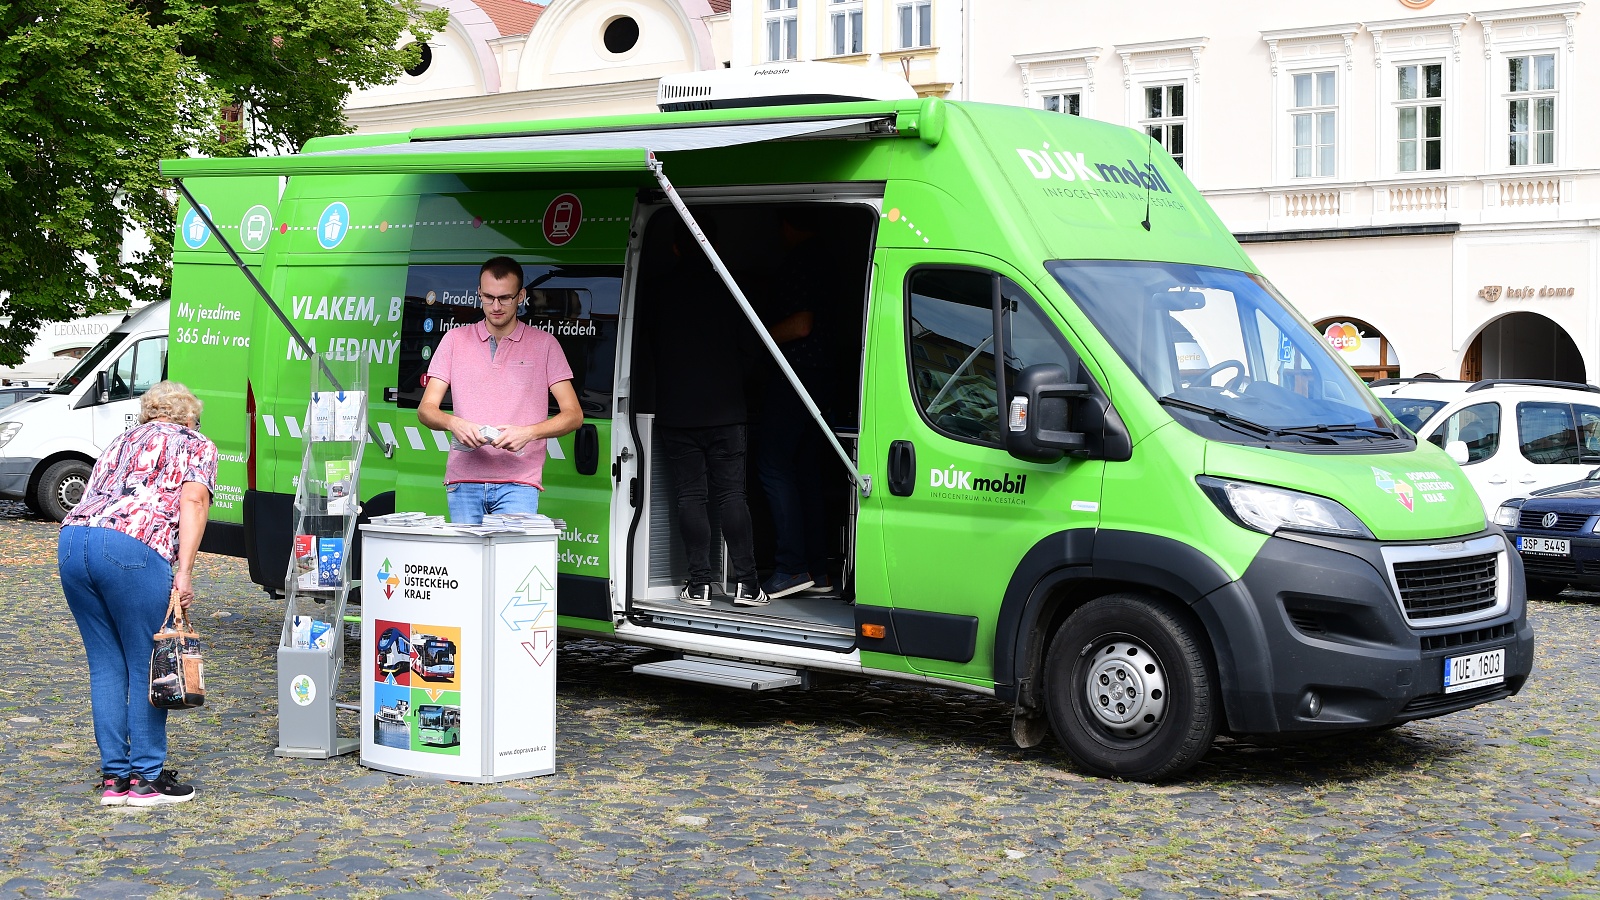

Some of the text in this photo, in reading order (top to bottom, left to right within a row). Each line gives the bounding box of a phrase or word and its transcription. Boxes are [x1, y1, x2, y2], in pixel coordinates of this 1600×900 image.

[1042, 187, 1187, 212] INFOCENTRUM NA ESTÁCH
[442, 290, 478, 309] Prodej
[1506, 285, 1575, 300] kafe doma
[177, 302, 241, 323] My jezdíme
[292, 295, 381, 327] VLAKEM,
[54, 323, 109, 336] LEONARDO
[557, 319, 596, 336] řádech
[176, 327, 199, 344] 365
[202, 327, 221, 346] dní
[223, 336, 230, 346] v
[1328, 334, 1357, 348] teta
[286, 331, 401, 365] NA JEDINÝ
[214, 484, 242, 494] DOPRAVA
[215, 500, 233, 509] KRAJE
[930, 491, 979, 502] INFOCENTRUM
[995, 497, 1026, 506] CESTÁCH
[1523, 538, 1566, 552] 3SP 5449
[404, 563, 449, 577] DOPRAVA
[404, 574, 459, 590] ÚSTECKÉHO
[404, 588, 431, 601] KRAJE
[1453, 658, 1471, 681] 1UE
[1478, 652, 1500, 677] 1603
[498, 745, 547, 757] www.dopravauk.cz
